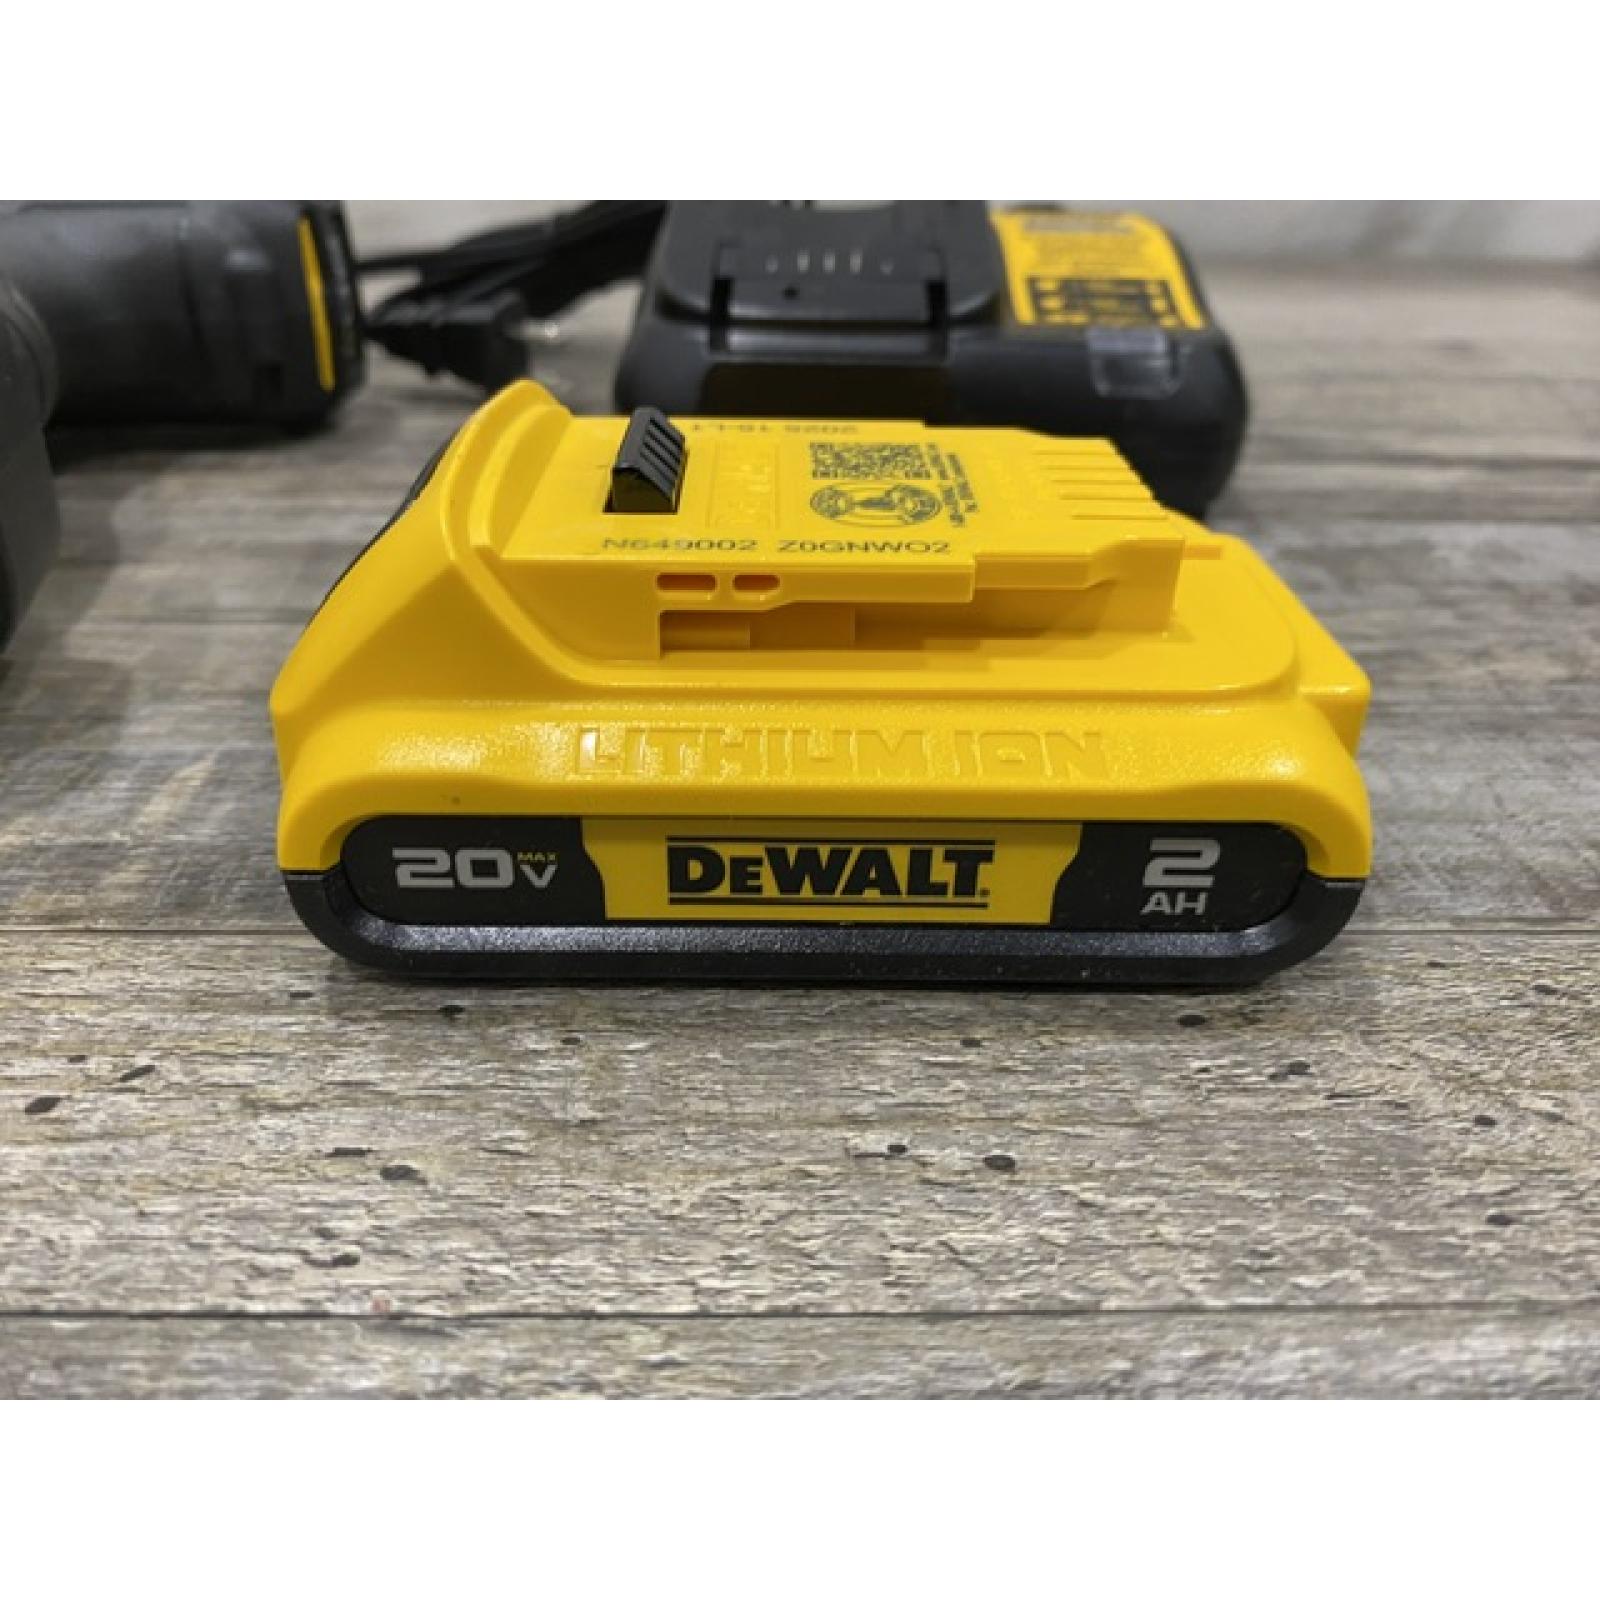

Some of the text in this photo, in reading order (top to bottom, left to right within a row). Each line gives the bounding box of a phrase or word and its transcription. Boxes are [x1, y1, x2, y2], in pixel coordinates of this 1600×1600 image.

[575, 728, 1102, 777] LITHIUM ION
[1143, 838, 1220, 888] 2
[1141, 892, 1207, 915] AH
